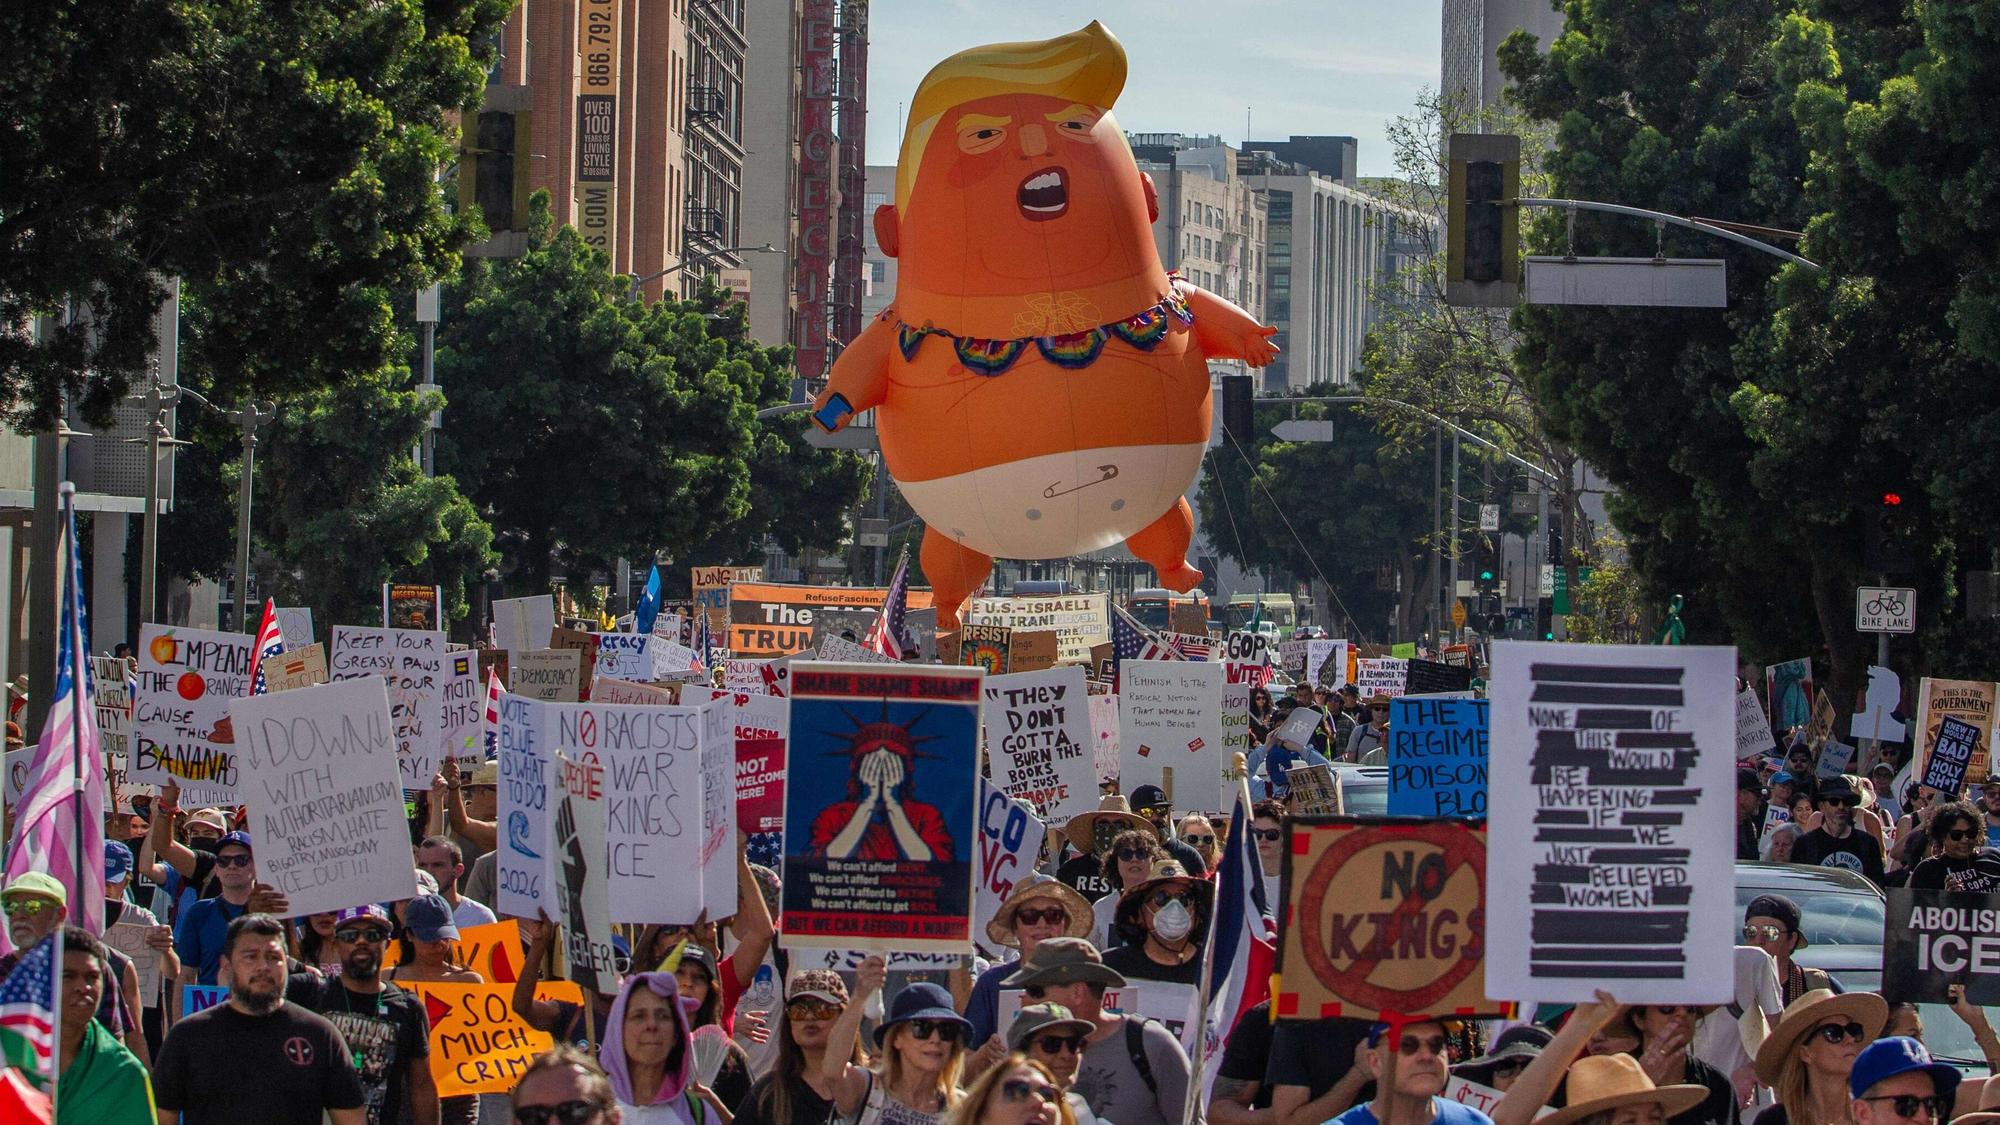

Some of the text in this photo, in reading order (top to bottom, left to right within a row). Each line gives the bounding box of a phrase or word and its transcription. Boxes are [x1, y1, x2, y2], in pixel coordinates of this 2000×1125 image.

[584, 101, 611, 115] OVER
[584, 116, 610, 134] 100
[584, 135, 610, 143] YEARS OF
[584, 143, 610, 154] LIVING
[583, 154, 610, 167] STYLE
[589, 168, 610, 176] DESIGN
[696, 568, 730, 586] LONG
[392, 591, 434, 599] BIGGER VOTE
[761, 603, 813, 625] The
[981, 616, 1002, 626] ON
[1009, 615, 1054, 626] IRAN!
[1861, 617, 1909, 627] BIKE LANE
[336, 631, 434, 651] KEEP YOUR
[963, 626, 1009, 644] RESIST
[1228, 632, 1266, 661] GOP
[166, 639, 252, 675] IMPEACH
[333, 652, 440, 672] GREASY PAWS
[725, 661, 756, 673] PROUD
[138, 671, 176, 692] THE
[401, 678, 435, 690] OUR
[521, 668, 576, 685] DEMOCRACY
[1128, 664, 1172, 687] FEMINISM
[540, 688, 561, 696] NOT
[797, 676, 976, 696] SHAME SHAME SHAME
[1943, 689, 1959, 697] THIS
[1970, 690, 1983, 698] THE
[1129, 692, 1161, 702] RADICAL
[1931, 697, 1992, 713] GOVERNMENT
[501, 699, 530, 726] VOTE
[1006, 704, 1065, 733] DON'T
[1132, 707, 1155, 715] THAT
[1158, 708, 1185, 716] WOMEN
[1401, 701, 1460, 726] THE
[1528, 707, 1680, 730] NONE OF
[175, 727, 208, 739] THIS
[560, 710, 699, 751] NO RACISTS
[1134, 719, 1196, 728] HUMAN BEINGS
[1946, 721, 1976, 737] KNEW IT
[262, 714, 372, 767] DOWN
[501, 725, 536, 756] BLUE
[1002, 729, 1071, 754] GOTTA
[1575, 729, 1611, 749] THIS
[1937, 737, 1968, 760] BAD
[137, 739, 238, 787] BANANAS
[1013, 743, 1082, 768] BURN THE
[1609, 749, 1671, 769] WOULD
[502, 753, 548, 784] IS WHAT
[610, 752, 677, 792] WAR
[736, 757, 768, 776] NOT
[1008, 763, 1054, 783] BOOKS
[1554, 766, 1582, 787] BE
[1931, 759, 1962, 778] HOLY
[262, 764, 334, 805] WITH
[565, 761, 606, 800] PEOPLE
[736, 770, 787, 788] WELCOME
[1003, 775, 1060, 794] THEY JUST
[507, 779, 525, 804] TO
[1538, 785, 1648, 808] HAPPENING
[265, 781, 398, 844] AUTHORITARIANISM
[608, 794, 683, 837] KINGS
[1593, 808, 1616, 829] IF
[349, 809, 389, 839] HATE
[1637, 826, 1674, 845] WE
[606, 842, 656, 879] ICE
[1545, 841, 1593, 865] JUST
[827, 861, 841, 870] We
[843, 862, 866, 872] can't
[868, 863, 896, 872] afford
[1381, 851, 1447, 900] NO
[1590, 866, 1687, 887] BELIEVED
[277, 870, 314, 894] ICE
[500, 867, 540, 899] 2026
[809, 873, 824, 883] We
[826, 874, 849, 884] can't
[851, 875, 879, 885] afford
[1967, 876, 1991, 891] COPS
[815, 886, 830, 896] We
[832, 886, 855, 896] can't
[857, 888, 885, 898] afford
[886, 888, 896, 898] to
[1565, 887, 1649, 907] WOMEN
[812, 898, 826, 909] We
[828, 899, 852, 909] can't
[853, 900, 880, 910] afford
[882, 901, 892, 910] to
[893, 901, 909, 912] get
[813, 919, 832, 930] WE
[835, 919, 858, 931] CAN
[863, 920, 908, 933] AFFORD
[912, 920, 920, 933] A
[1329, 908, 1486, 961] KINGS
[1918, 934, 2000, 974] ICE
[440, 1027, 536, 1059] MUCH.
